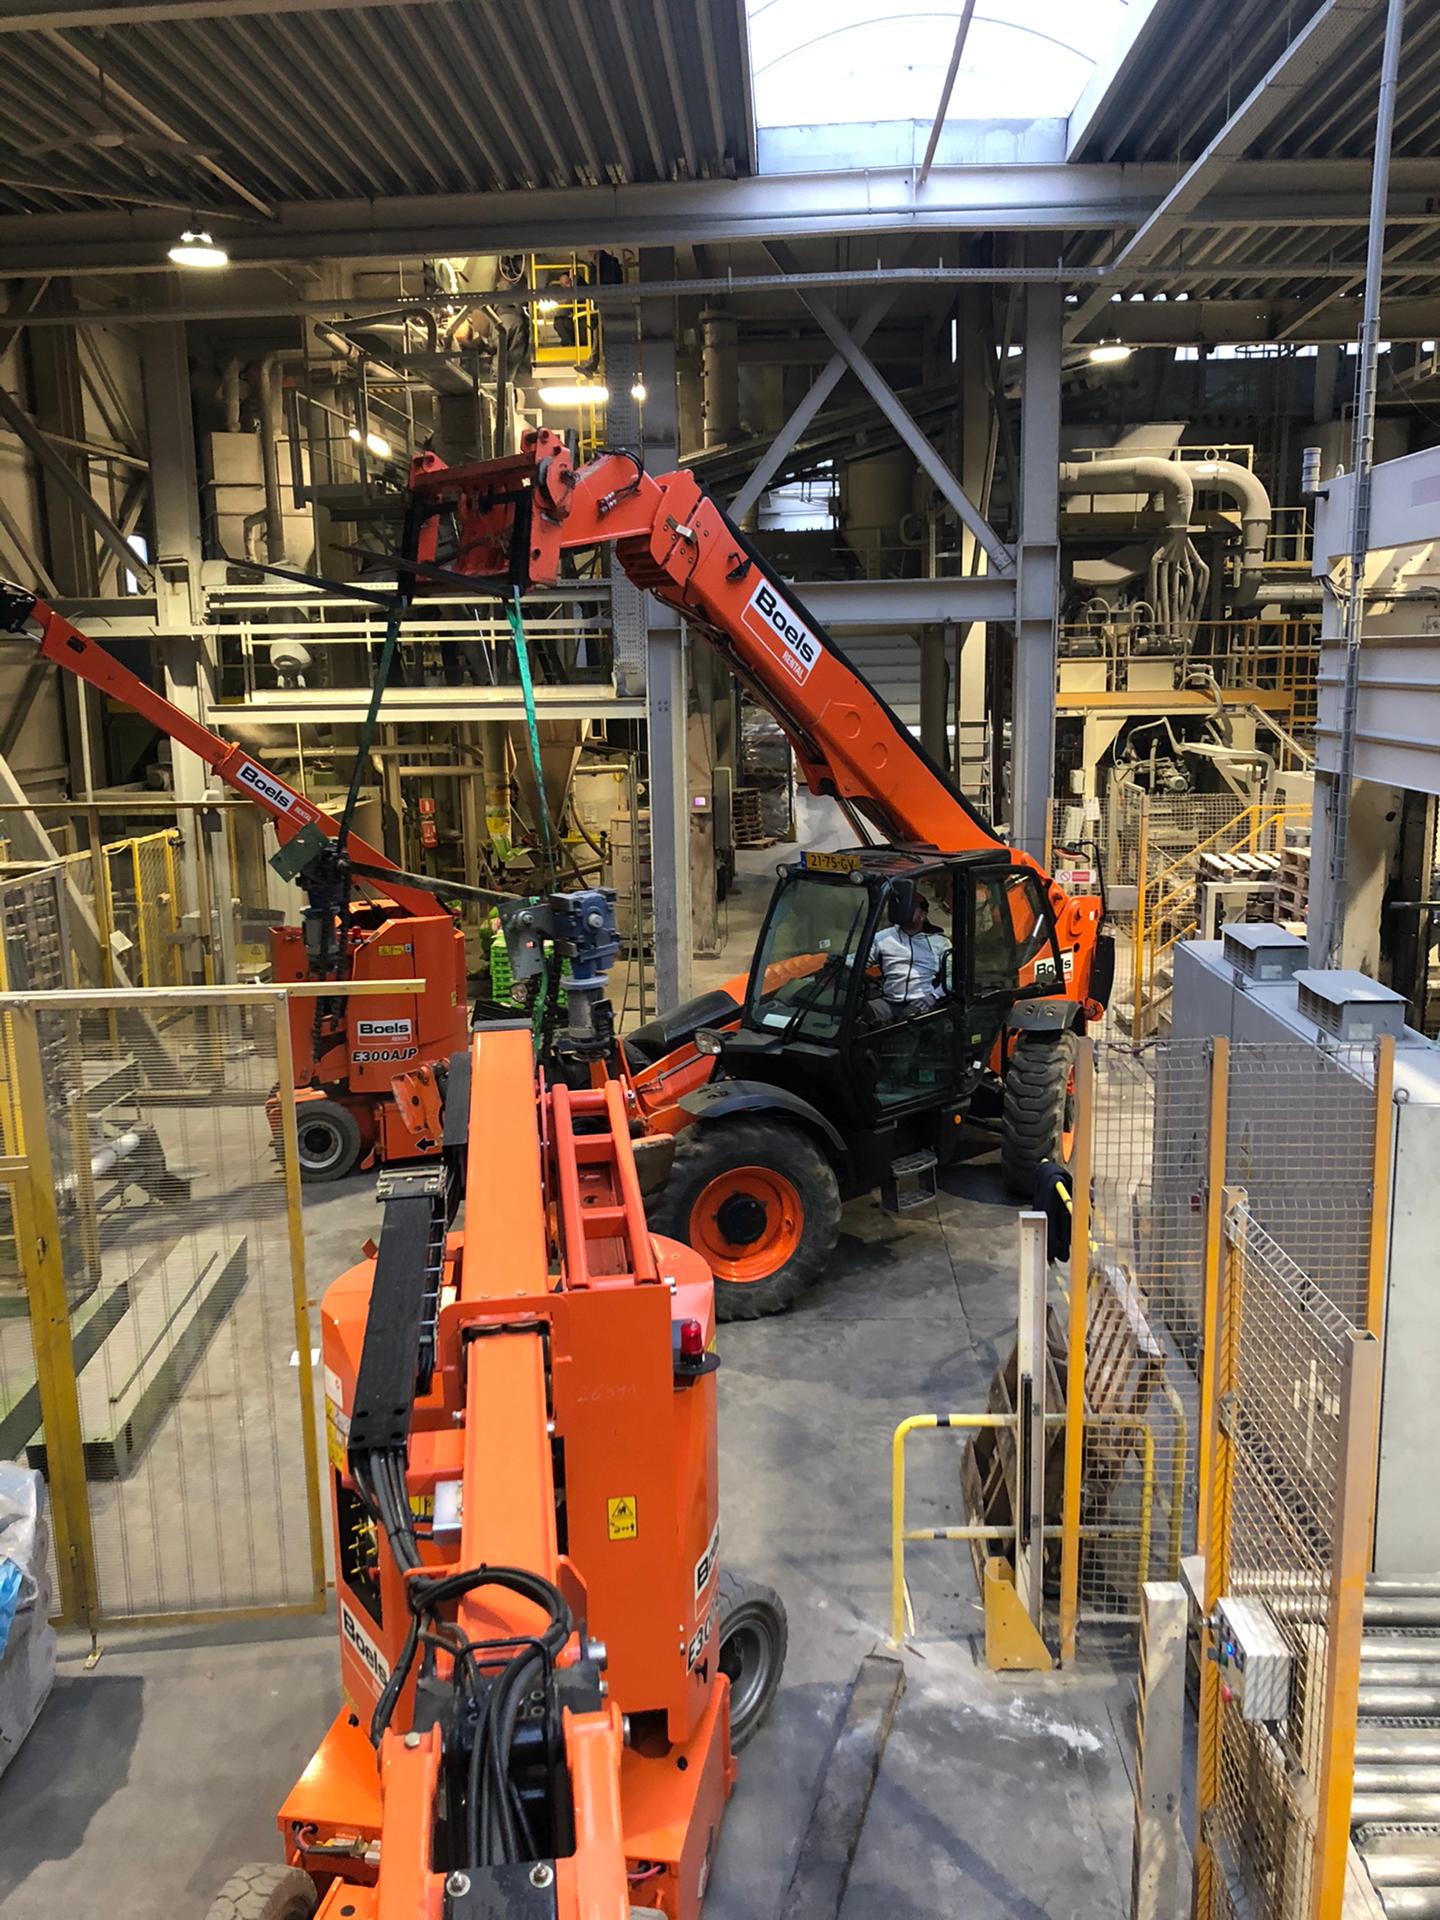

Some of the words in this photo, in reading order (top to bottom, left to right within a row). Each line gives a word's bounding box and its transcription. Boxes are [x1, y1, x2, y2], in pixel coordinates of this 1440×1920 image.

[755, 586, 815, 664] Boels
[782, 650, 805, 680] RENTAL
[240, 765, 290, 808] Boels
[1036, 958, 1072, 975] Bos
[359, 1022, 409, 1035] Boels
[352, 1048, 418, 1063] E300AJP
[343, 1607, 388, 1687] Boels
